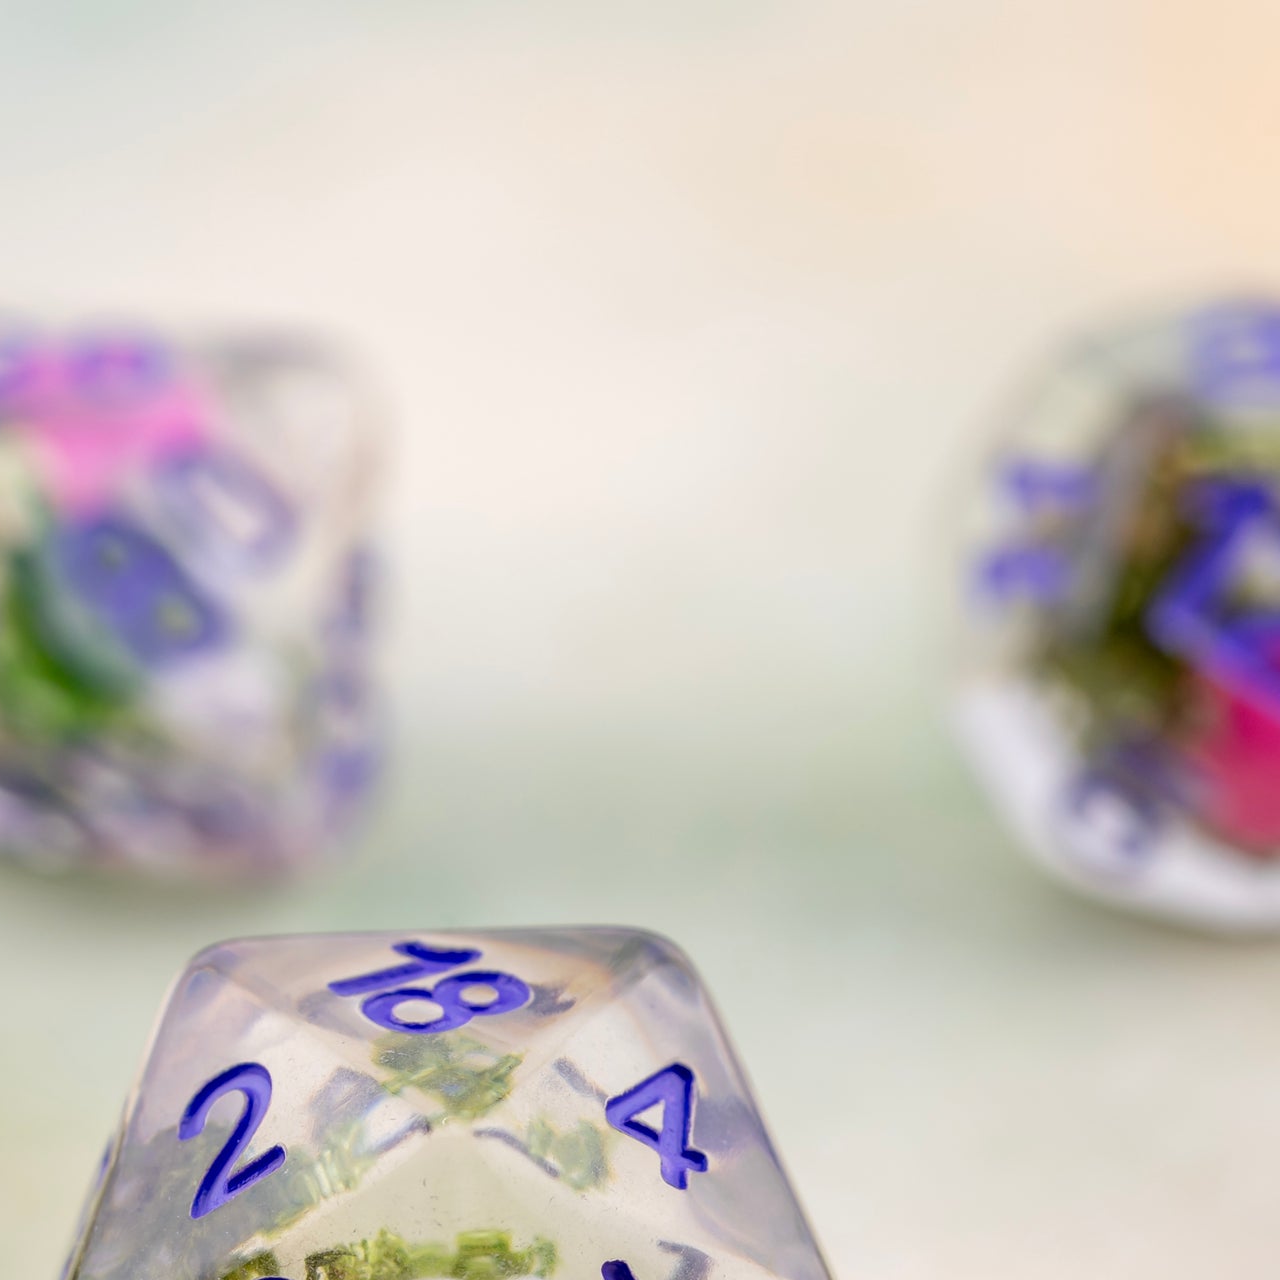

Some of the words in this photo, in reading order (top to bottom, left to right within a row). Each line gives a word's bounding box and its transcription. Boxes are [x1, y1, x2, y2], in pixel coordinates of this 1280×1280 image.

[328, 940, 532, 1034] 18
[179, 1061, 287, 1219] 2
[605, 1061, 709, 1190] 4
